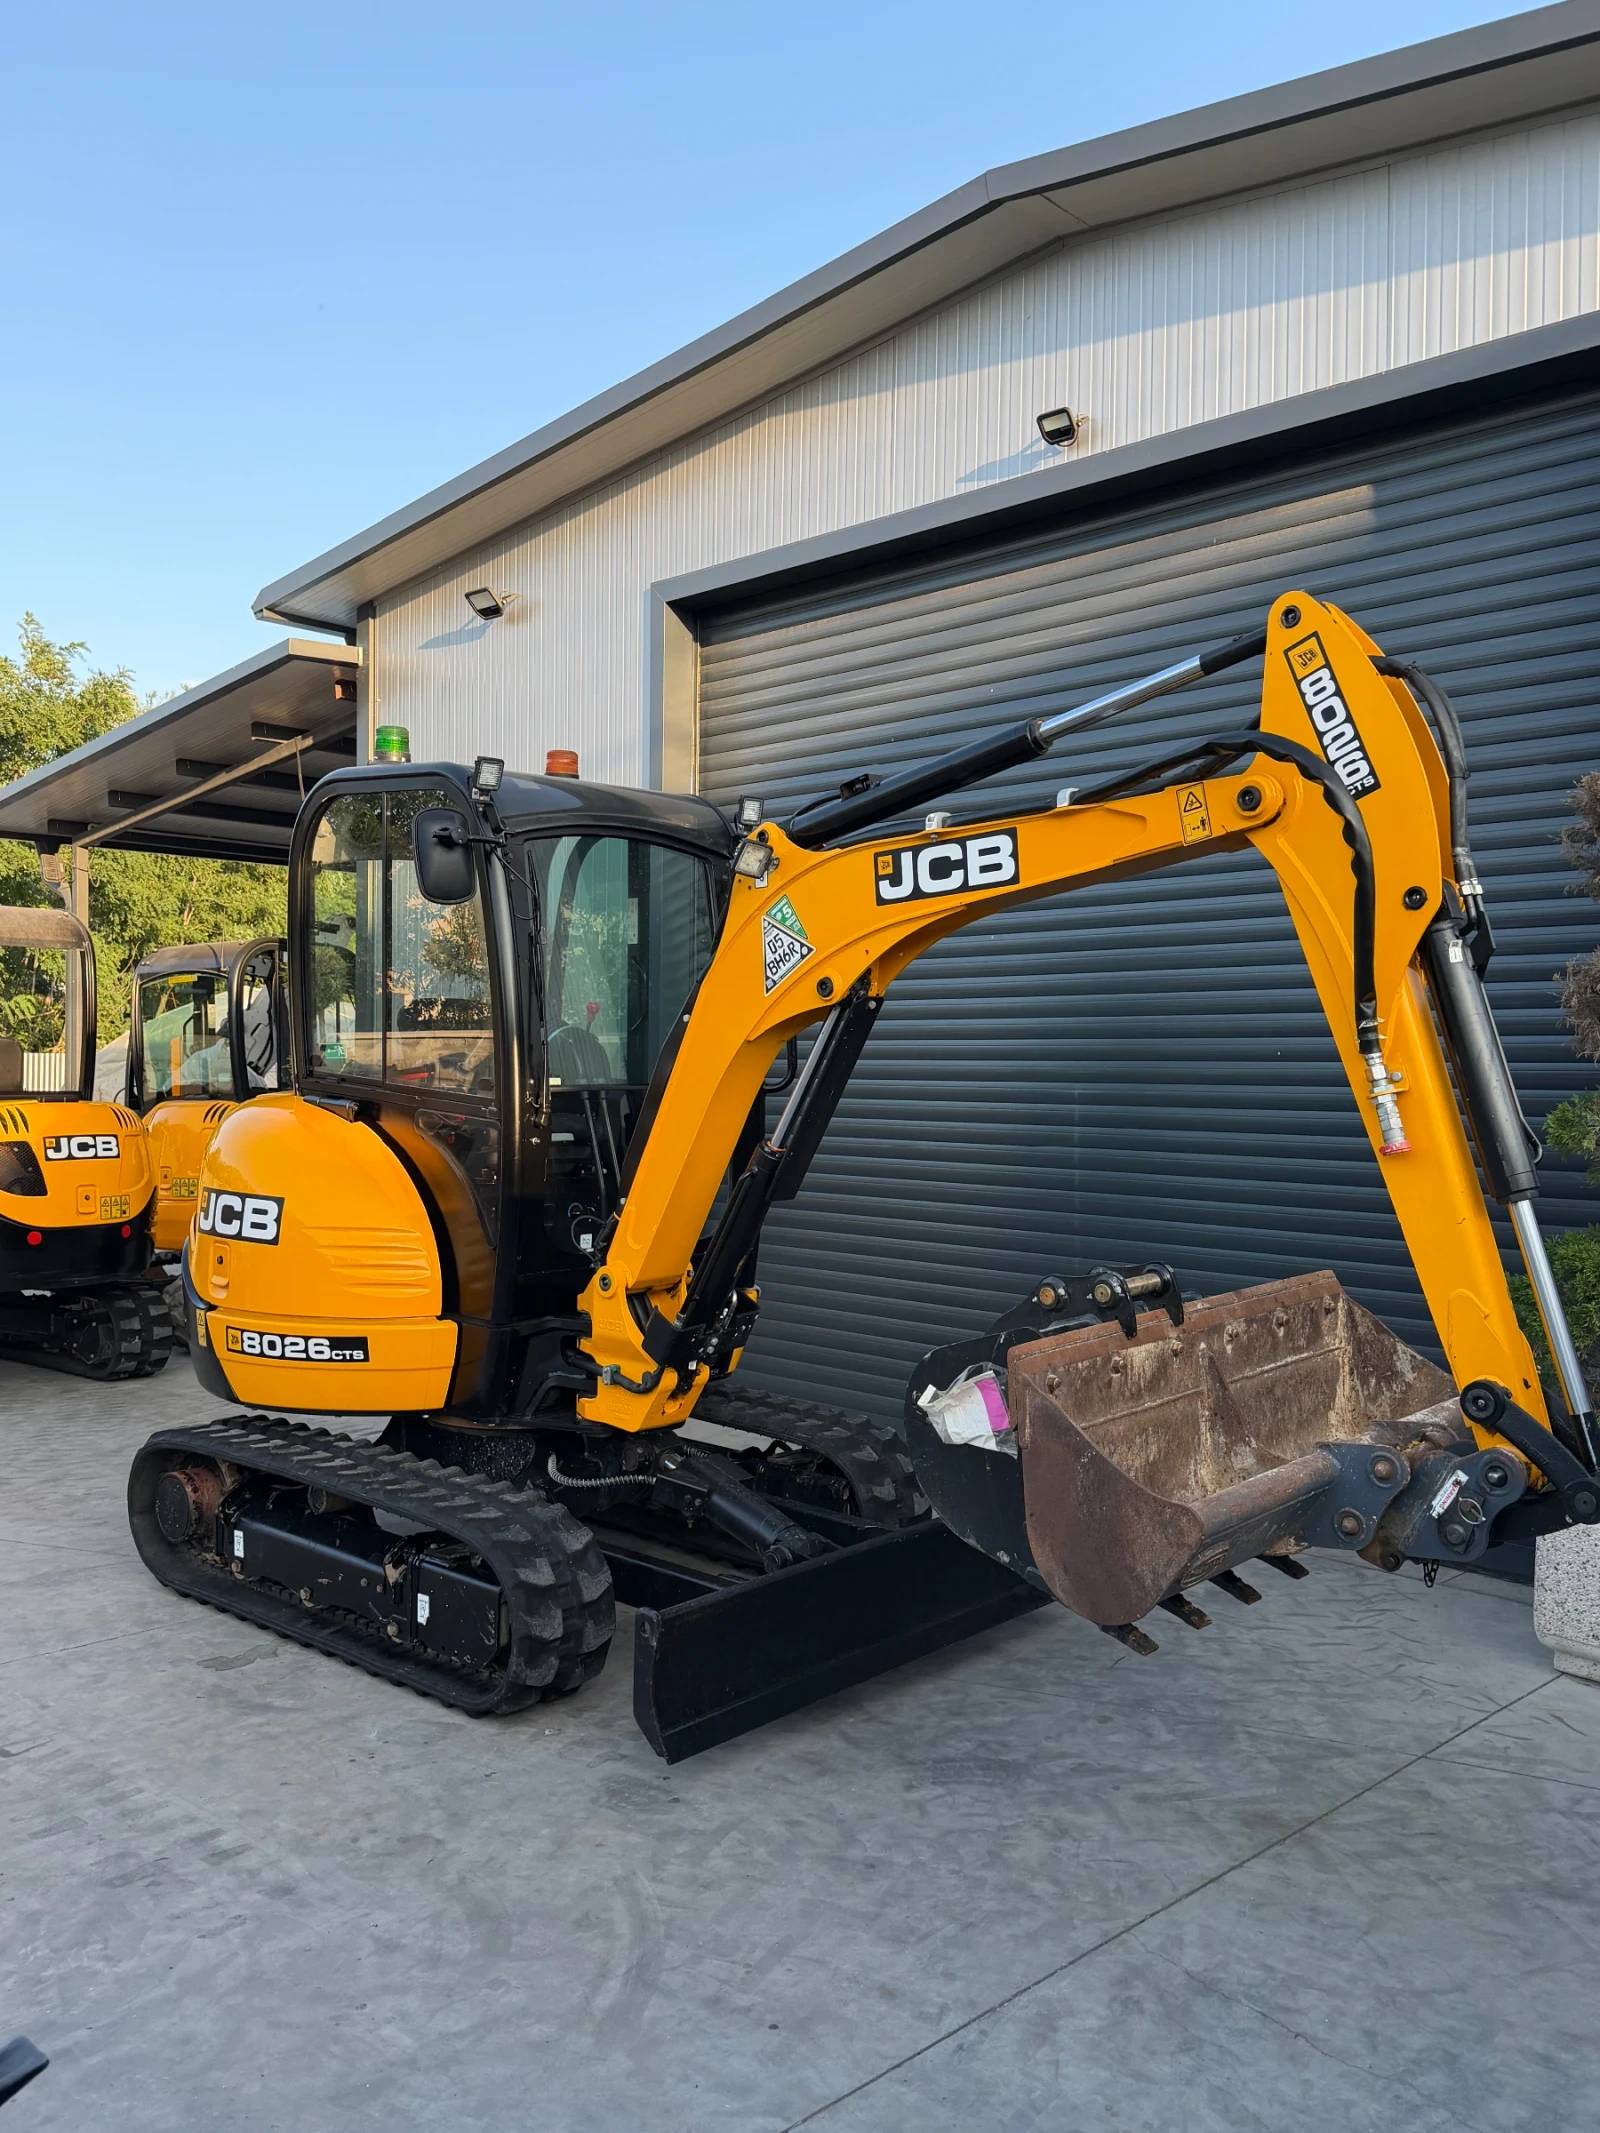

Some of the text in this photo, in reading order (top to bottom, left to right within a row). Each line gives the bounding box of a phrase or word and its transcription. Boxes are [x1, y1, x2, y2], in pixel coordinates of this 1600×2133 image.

[1298, 650, 1317, 667] JCB
[1301, 668, 1370, 786] 8026
[879, 835, 1015, 900] JCB
[782, 904, 792, 918] 5
[767, 941, 799, 976] BH6R
[47, 1136, 118, 1159] JCB
[199, 1193, 279, 1240] JCB
[242, 1331, 331, 1360] 8026
[331, 1350, 364, 1360] CTS
